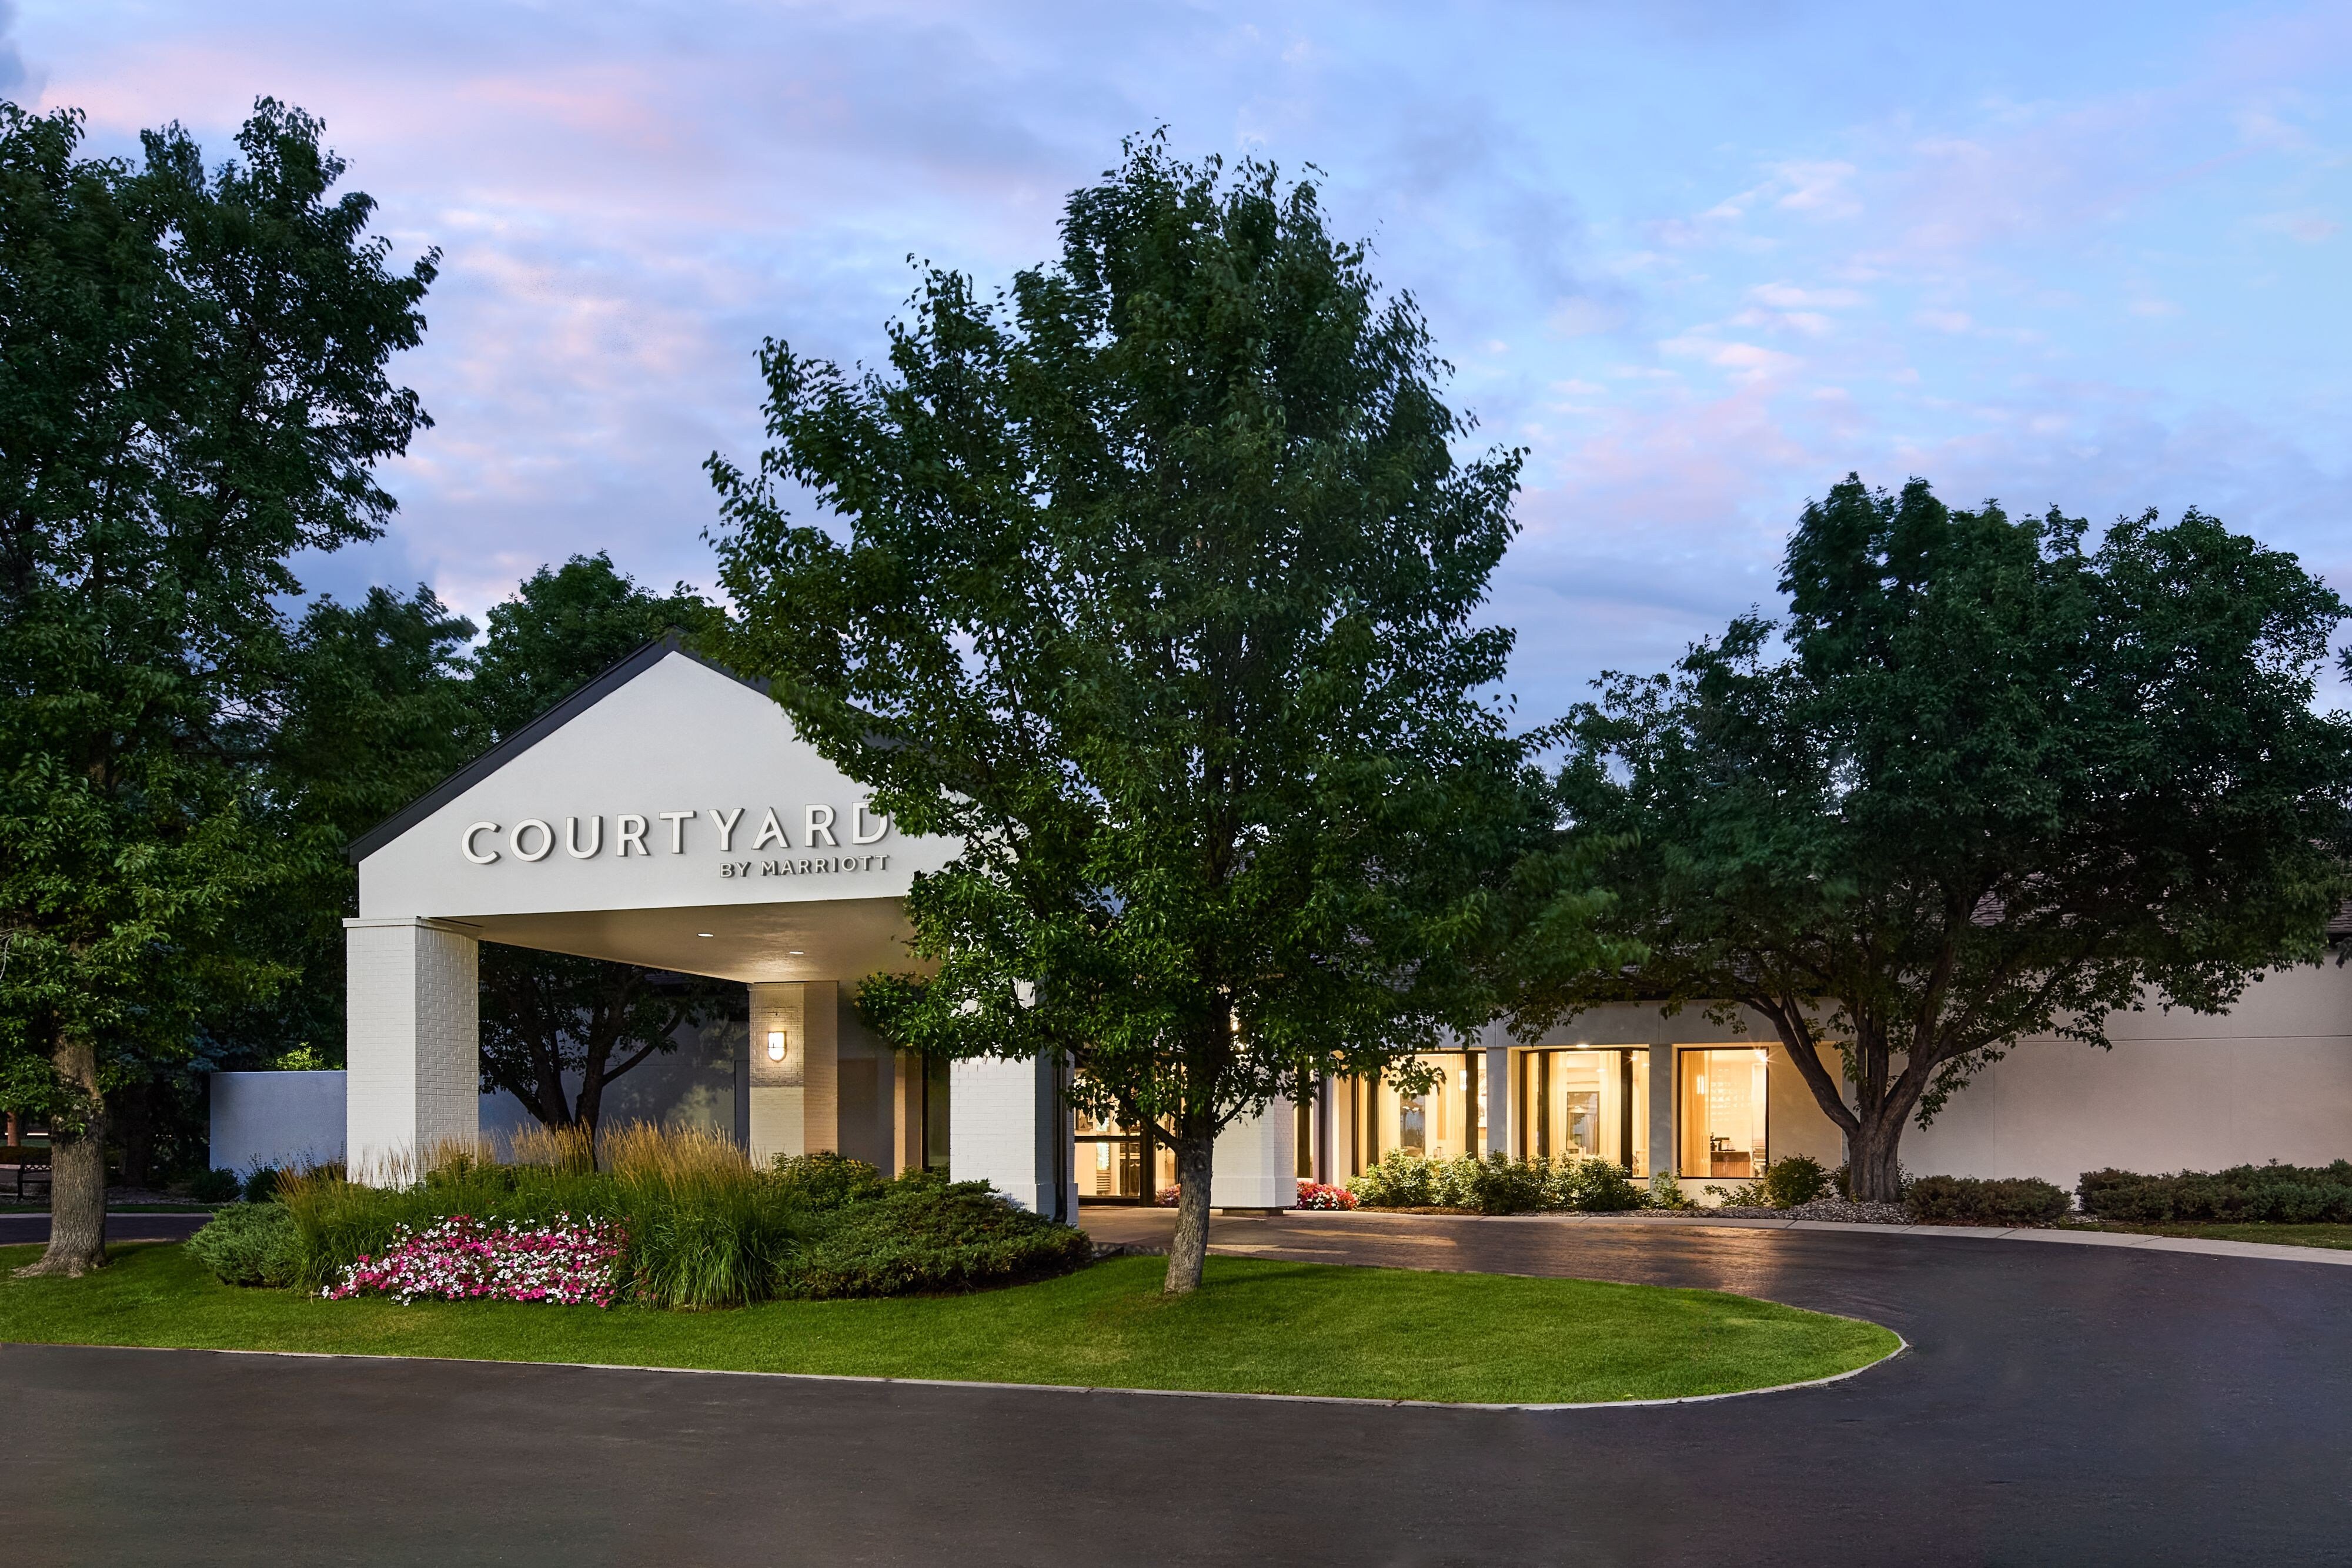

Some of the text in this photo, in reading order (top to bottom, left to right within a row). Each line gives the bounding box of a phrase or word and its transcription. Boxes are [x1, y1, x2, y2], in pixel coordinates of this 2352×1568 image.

[461, 801, 890, 864] COURTYARD
[720, 854, 890, 877] BY MARRIOTT
